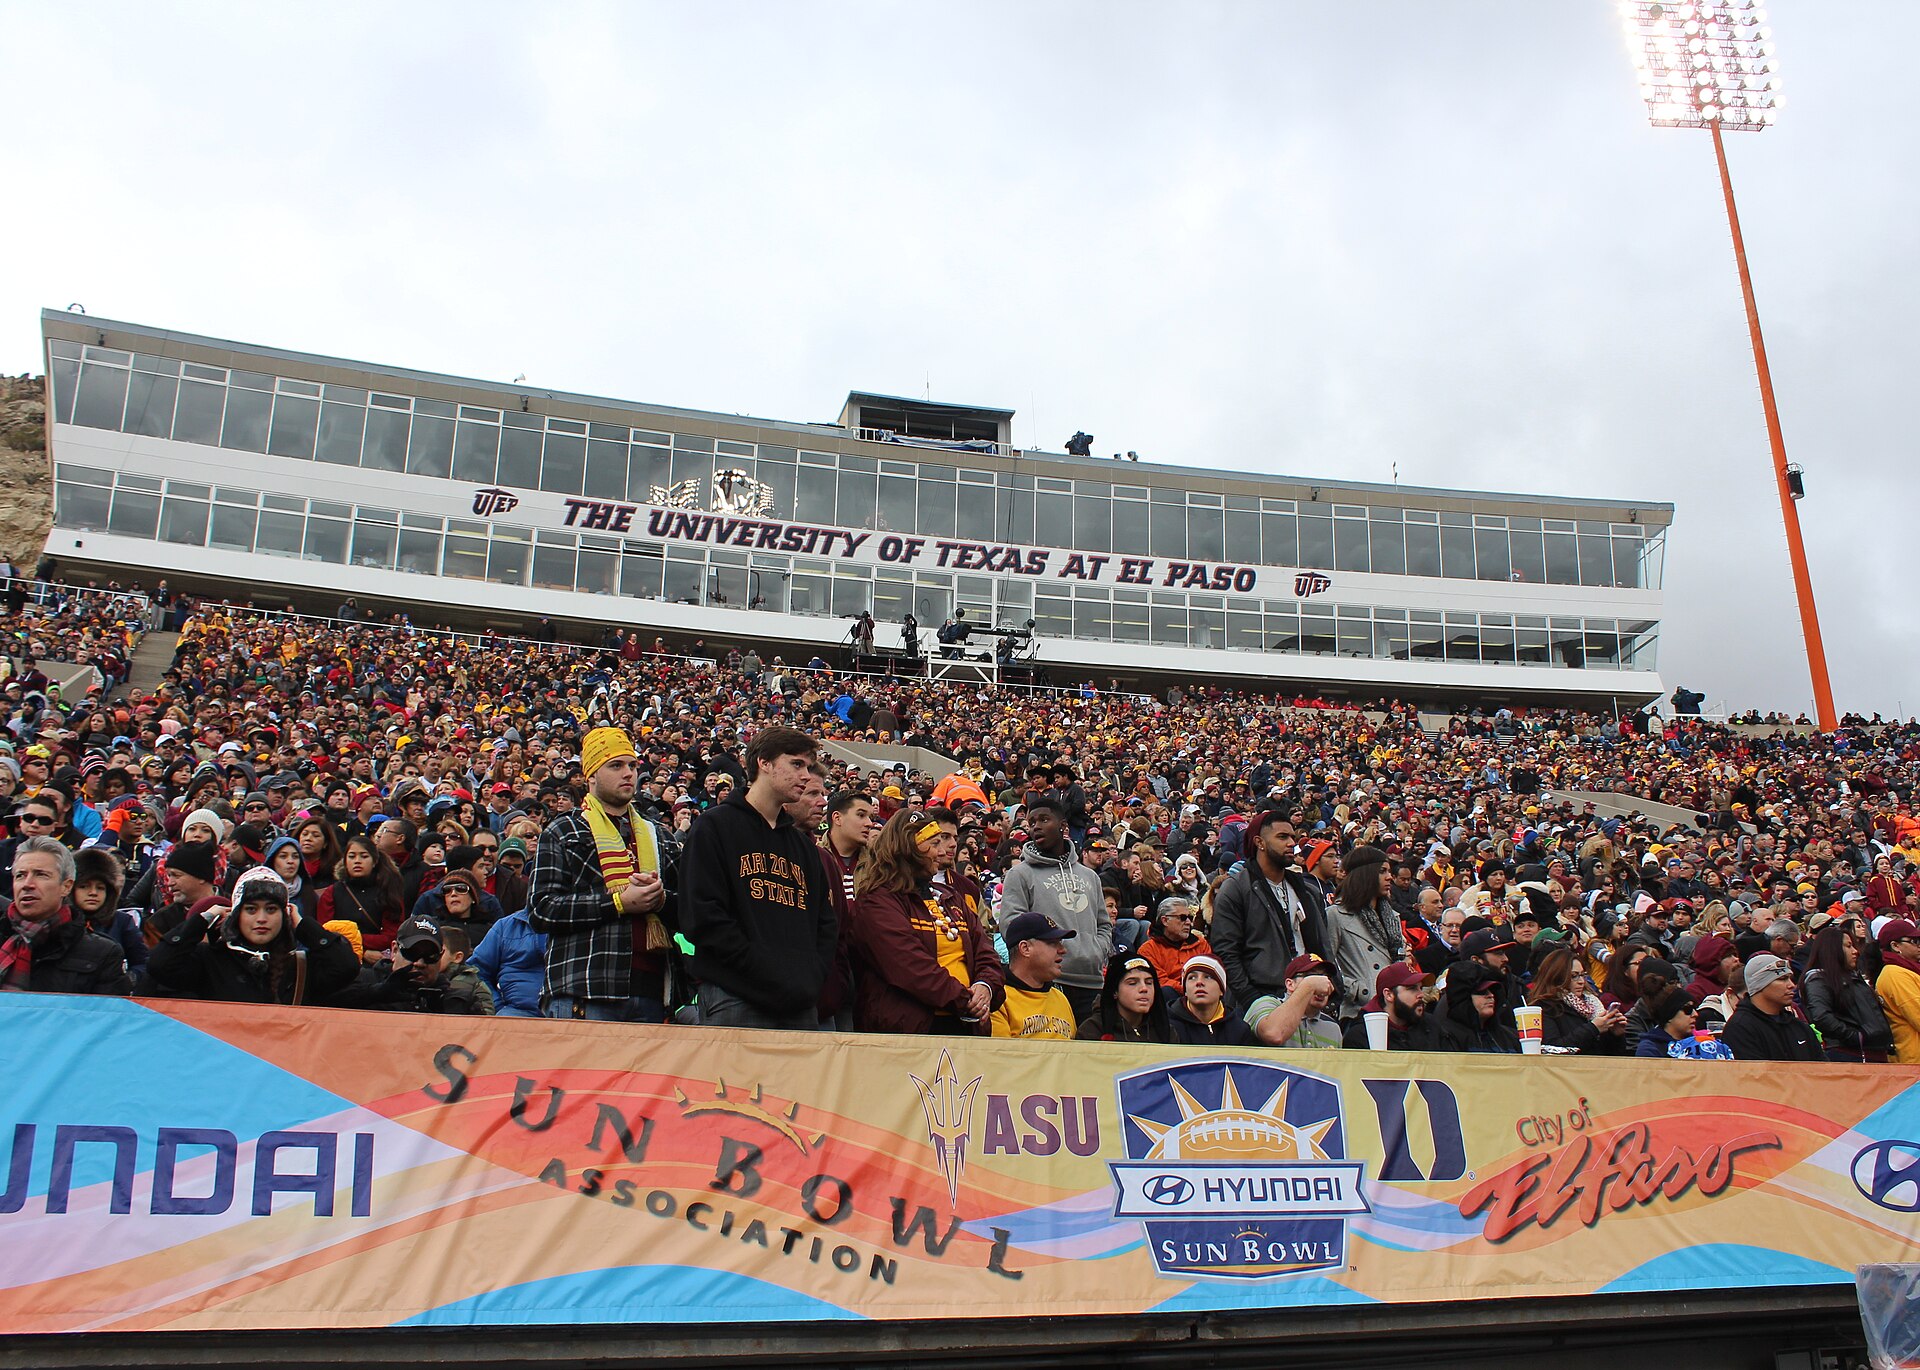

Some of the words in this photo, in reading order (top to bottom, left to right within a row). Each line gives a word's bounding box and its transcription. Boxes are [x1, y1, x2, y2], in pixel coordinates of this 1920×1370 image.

[472, 488, 519, 517] UTEP
[562, 497, 637, 533] THE
[647, 509, 871, 558] UNIVERSITY
[877, 535, 926, 563] OF
[935, 540, 1050, 575] TEXAS
[1058, 553, 1109, 580] AT
[1116, 557, 1154, 585] EL
[1163, 561, 1257, 593] PASO
[1294, 571, 1331, 598] UTEP
[750, 878, 807, 910] STATE
[983, 1094, 1100, 1156] ASU
[1360, 1078, 1468, 1182] D
[1515, 1114, 1565, 1146] City
[1566, 1097, 1592, 1131] of
[421, 1043, 655, 1164] SUN
[709, 1135, 1025, 1280] BOWL
[1459, 1135, 1591, 1243] El
[1572, 1121, 1782, 1227] Paso
[1204, 1177, 1343, 1202] HYUNDAI
[538, 1157, 898, 1286] ASSOCIATION
[1161, 1239, 1227, 1263] SUN
[1243, 1238, 1339, 1263] BOWL
